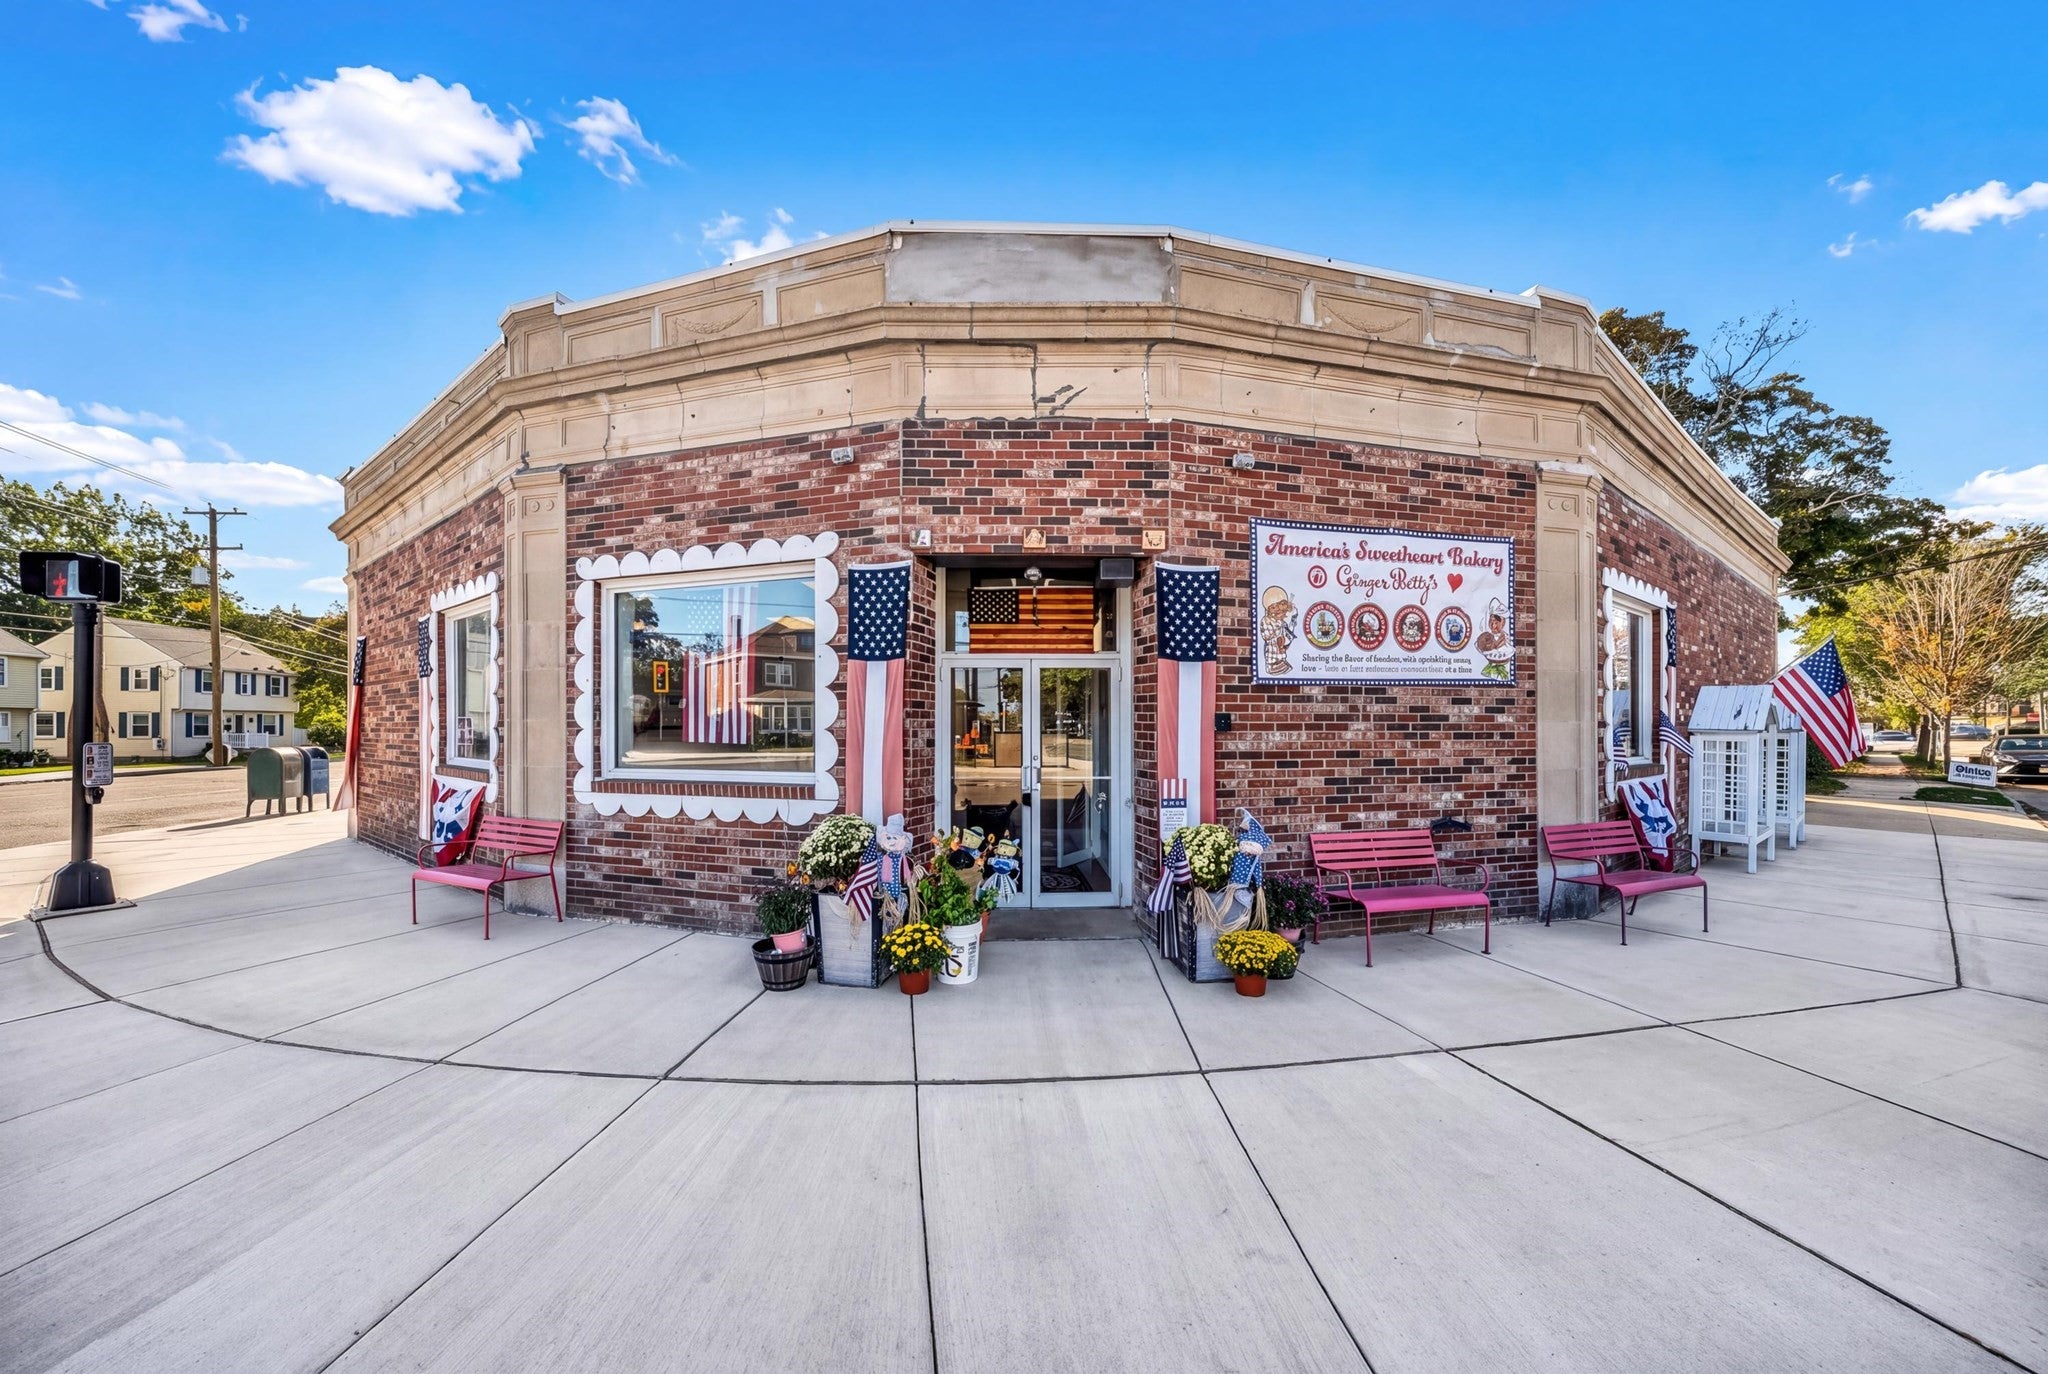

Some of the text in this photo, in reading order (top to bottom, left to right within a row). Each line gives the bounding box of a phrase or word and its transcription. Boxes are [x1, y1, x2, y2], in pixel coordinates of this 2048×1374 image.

[1265, 533, 1503, 575] America's Sweetheart Bakery
[1336, 564, 1438, 606] Ginger Betty's
[1302, 654, 1330, 664] Sharing
[1332, 654, 1343, 662] the
